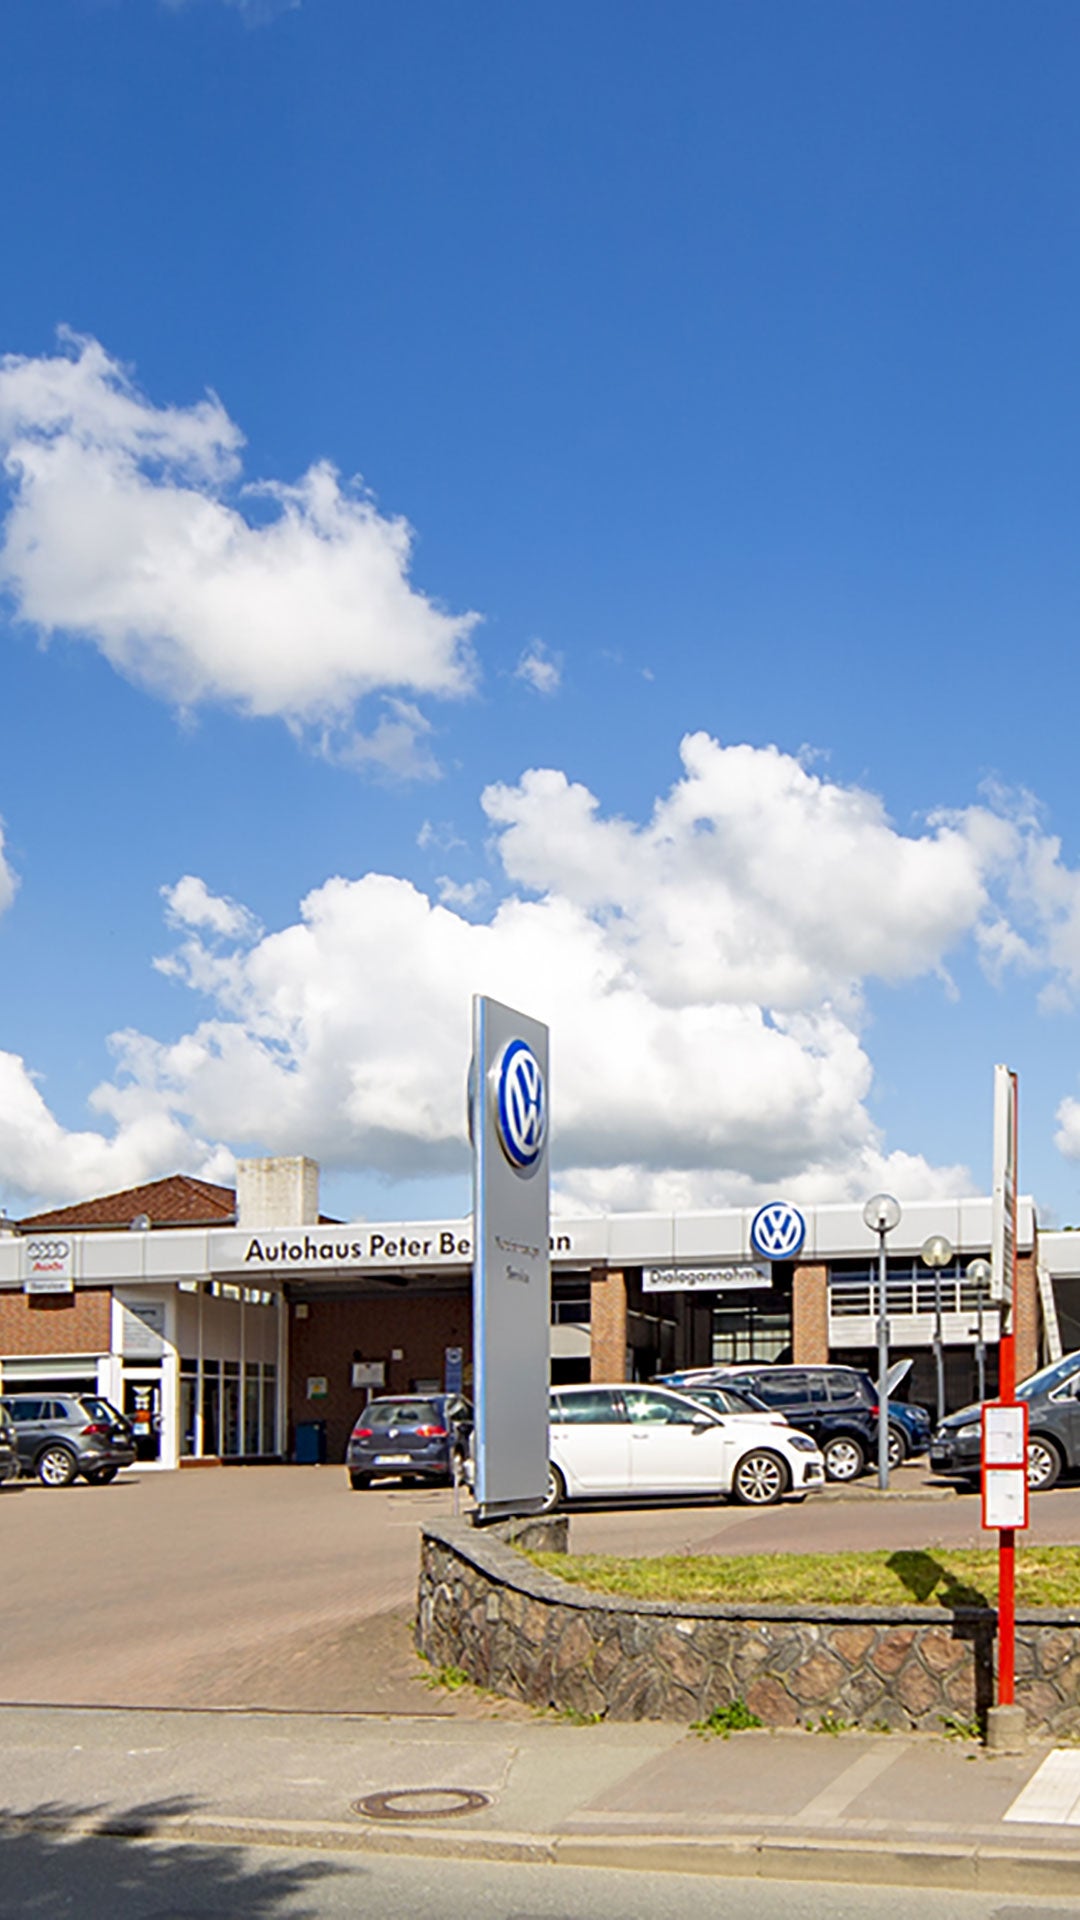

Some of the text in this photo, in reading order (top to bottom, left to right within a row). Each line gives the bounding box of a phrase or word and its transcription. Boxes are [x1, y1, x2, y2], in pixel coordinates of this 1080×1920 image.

[245, 1235, 362, 1263] Autohaus
[370, 1233, 431, 1257] Peter
[439, 1232, 471, 1255] Be
